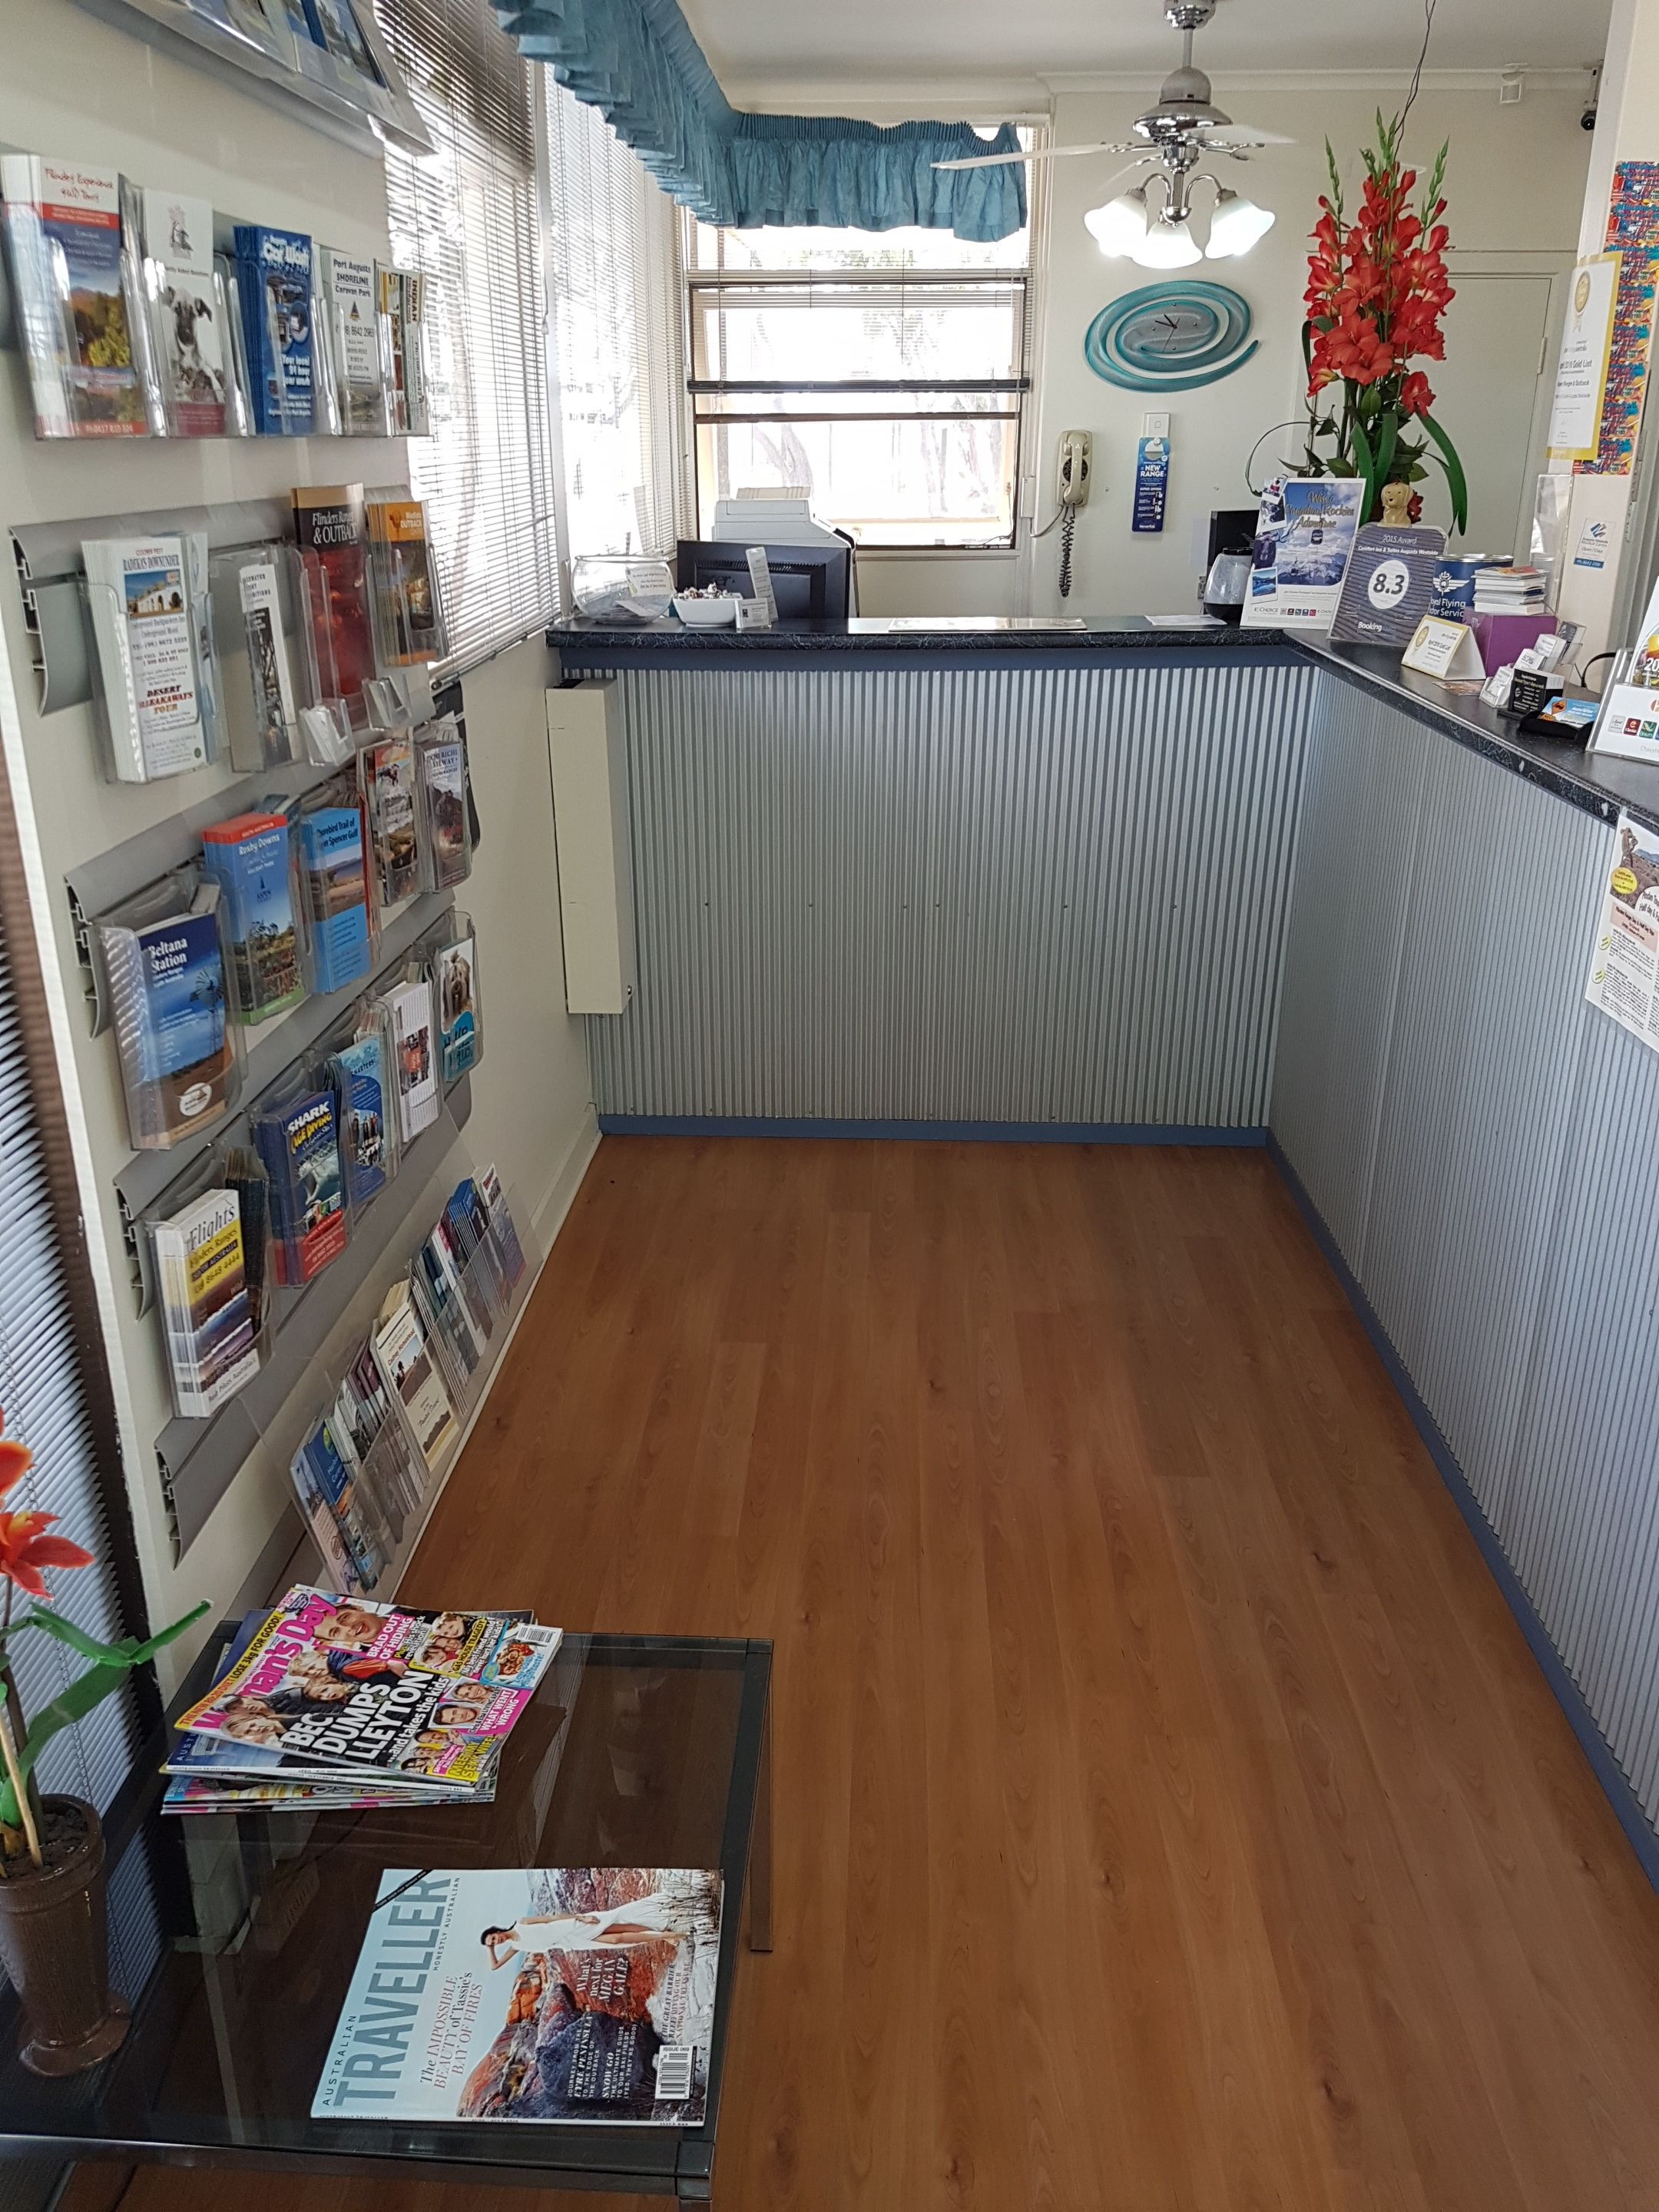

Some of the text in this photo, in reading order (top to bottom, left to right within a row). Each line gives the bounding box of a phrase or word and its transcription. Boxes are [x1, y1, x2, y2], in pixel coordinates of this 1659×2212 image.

[333, 259, 371, 274] Port Augusta
[336, 272, 369, 286] SHORELINE
[335, 284, 371, 298] Caravan Park
[1285, 503, 1355, 517] Canadian Rockies
[1307, 490, 1329, 505] Win
[312, 511, 339, 527] Flinders
[1297, 515, 1337, 528] Adventure
[313, 528, 323, 545] &
[1382, 535, 1417, 545] 2015 Award
[1373, 573, 1406, 595] 8.3
[1440, 609, 1465, 618] Servic
[1442, 599, 1467, 610] Flying
[147, 684, 182, 697] DESERT
[329, 827, 359, 848] Spencer Gulf
[338, 819, 350, 832] Trail
[238, 833, 280, 856] Roxby Downs
[148, 937, 189, 959] Beltana
[151, 952, 188, 972] Station
[288, 1100, 330, 1134] SHARK
[306, 1111, 333, 1138] DIVING
[189, 1206, 235, 1250] Flights
[275, 1593, 338, 1642] Day
[410, 1614, 427, 1637] shock
[231, 1664, 246, 1682] LOSE
[242, 1651, 259, 1667] 3kg
[253, 1637, 265, 1653] FOR
[261, 1613, 283, 1640] GOOD!
[366, 1614, 402, 1658] BRAD OUT
[379, 1616, 414, 1660] OF HIDING
[404, 1626, 429, 1661] revelation!
[452, 1619, 487, 1672] GAS HOUSE TRAGEDY
[531, 1653, 545, 1673] taste!
[310, 1681, 392, 1756] DUMPS
[345, 1670, 435, 1761] LLEYTON
[399, 1674, 451, 1740] takes the kids
[479, 1689, 512, 1731] WHAT WENT
[495, 1698, 520, 1726] WRONG
[280, 1713, 334, 1747] BEC
[432, 1876, 461, 1972] HONESTLY AUSTRALIAN
[333, 1876, 452, 2108] TRAVELLER
[576, 1958, 591, 1992] What's
[590, 1974, 602, 1997] next
[599, 1959, 616, 2002] MEGAN
[614, 1956, 628, 1997] GALE?
[667, 1962, 677, 1997] BARRIER
[664, 1997, 673, 2022] GREAT
[672, 1971, 683, 2017] DIVING OUR
[675, 1961, 691, 2040] NATIONAL TREASURE
[420, 1975, 458, 2085] The IMPOSSIBLE
[434, 1972, 473, 2090] BEAUTY of Tassie's
[451, 1983, 483, 2076] BAY OF FIRES
[322, 2015, 356, 2106] AUSTRALIAN
[591, 2048, 601, 2083] OUTBACK
[601, 2051, 614, 2099] SNOW GO
[612, 2048, 623, 2084] ULTIMATE
[625, 2048, 634, 2078] THEY'RE
[567, 2059, 578, 2098] JOURNEY
